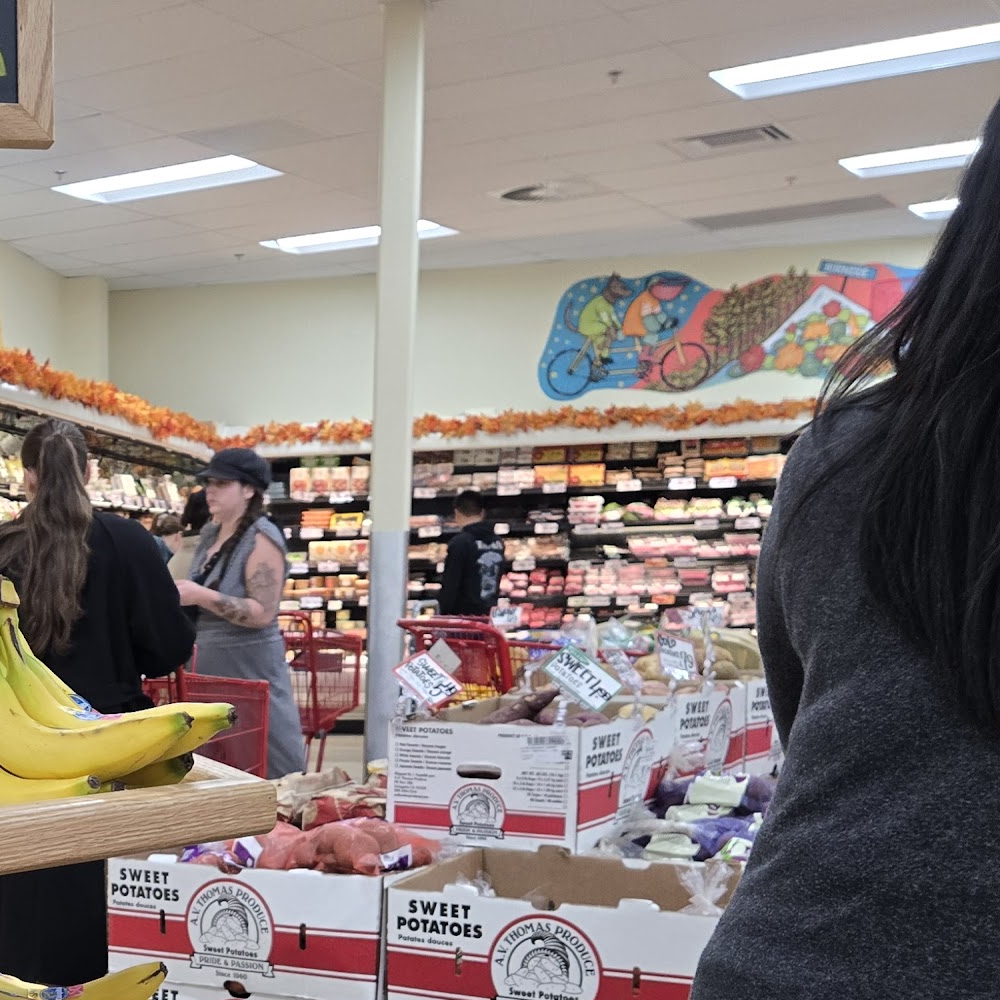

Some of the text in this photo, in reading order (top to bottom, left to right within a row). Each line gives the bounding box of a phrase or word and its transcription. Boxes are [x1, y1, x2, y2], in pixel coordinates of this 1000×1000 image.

[417, 657, 449, 681] SWEET
[556, 652, 597, 684] SWEET
[685, 700, 710, 715] SWEET
[592, 732, 621, 748] SWEET
[585, 749, 623, 769] POTATOES
[119, 867, 169, 885] SWEET
[111, 883, 180, 902] POTATOES
[196, 885, 234, 908] THOMAS
[235, 888, 269, 934] PRODUCE
[408, 899, 471, 919] SWEET
[397, 916, 482, 939] POTATOES
[203, 944, 258, 958] Sweet Potatoes
[503, 922, 551, 946] THOMAS
[554, 925, 595, 976] PRODUCE
[199, 956, 221, 966] PRIDE
[230, 959, 264, 970] PASSION
[509, 986, 536, 998] Sweet
